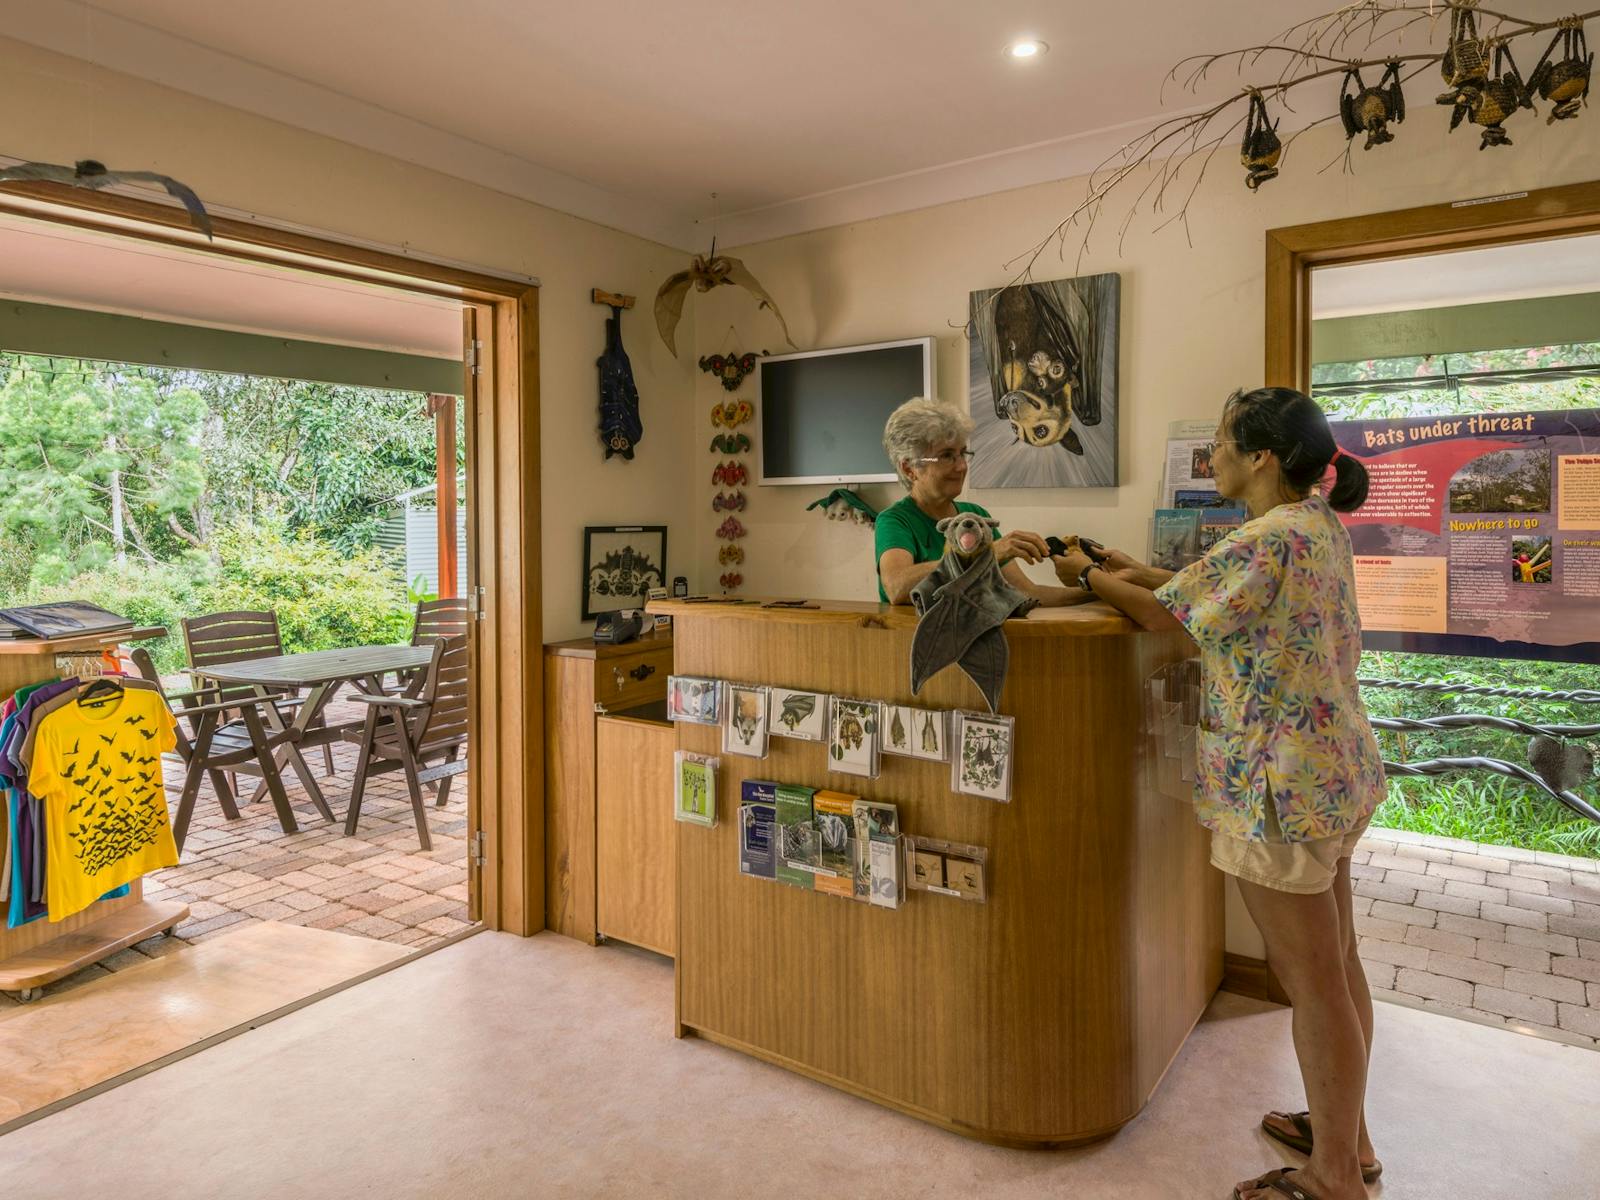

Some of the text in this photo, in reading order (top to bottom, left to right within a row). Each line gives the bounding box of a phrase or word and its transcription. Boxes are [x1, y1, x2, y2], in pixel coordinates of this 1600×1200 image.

[1364, 414, 1535, 448] Bats under threat
[1449, 518, 1539, 532] Nowhere to go
